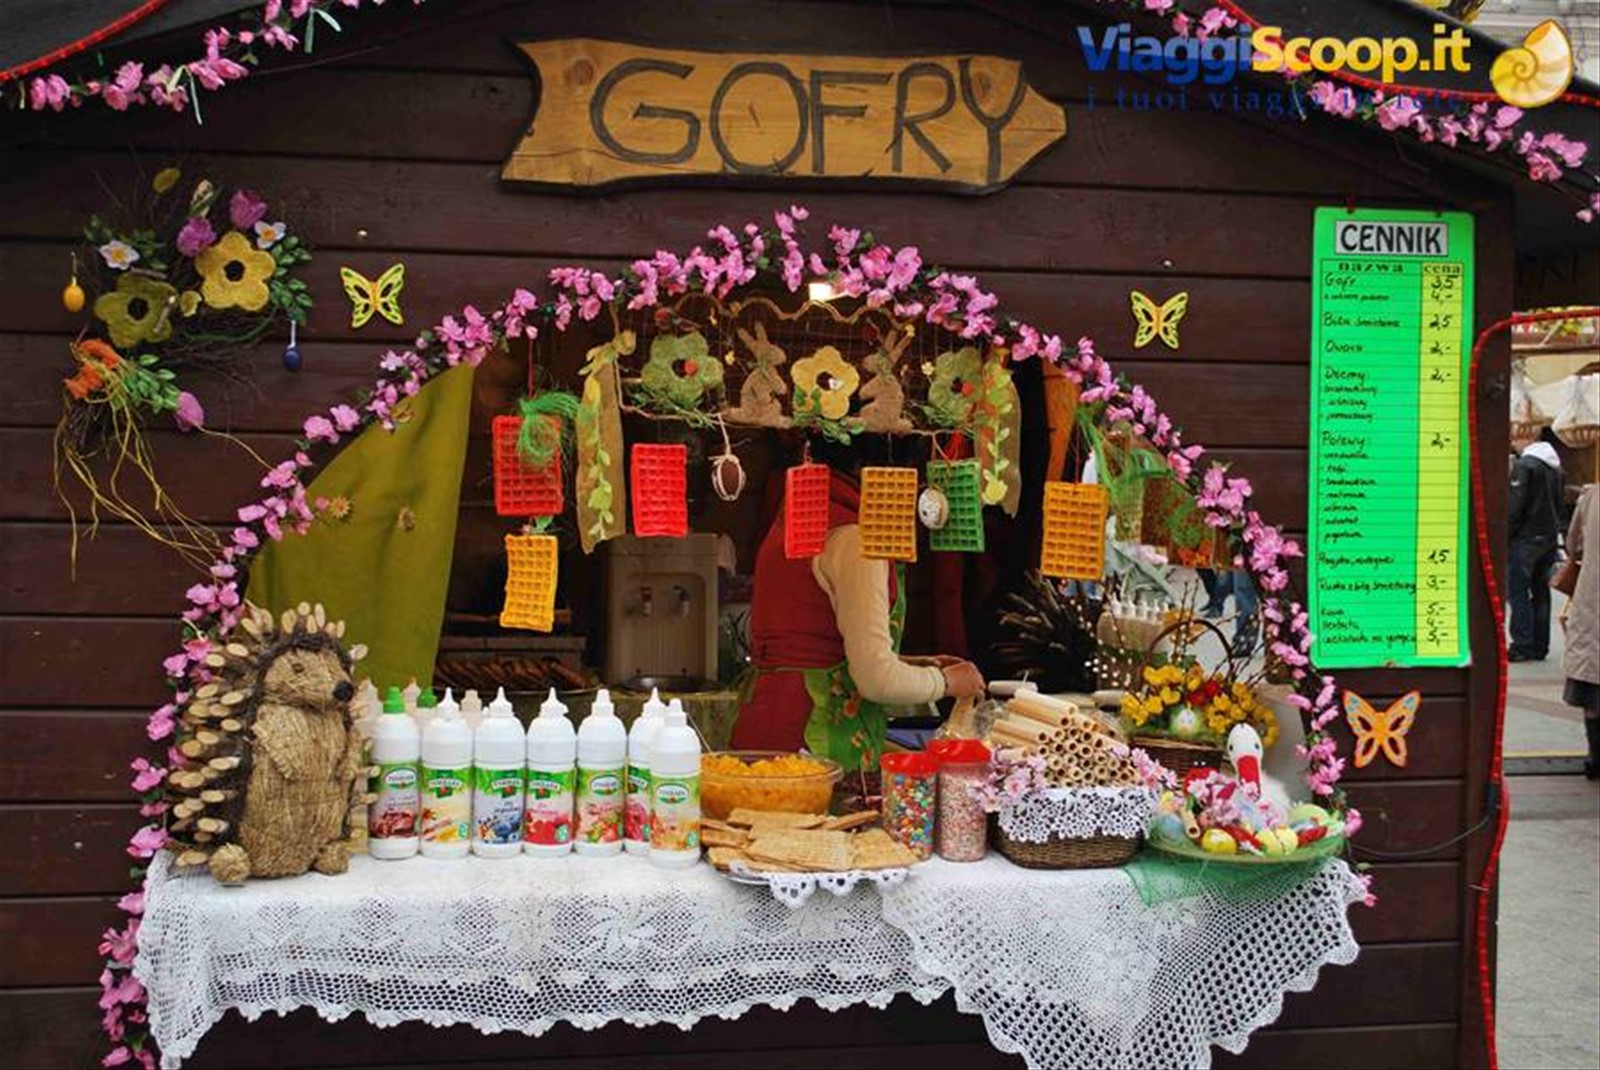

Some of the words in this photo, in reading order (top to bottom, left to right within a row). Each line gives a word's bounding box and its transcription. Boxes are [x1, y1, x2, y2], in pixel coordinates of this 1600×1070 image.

[589, 57, 1027, 186] GOFRY
[1340, 224, 1442, 253] CENNIK
[1339, 263, 1403, 272] nazwa
[1424, 264, 1460, 274] cena
